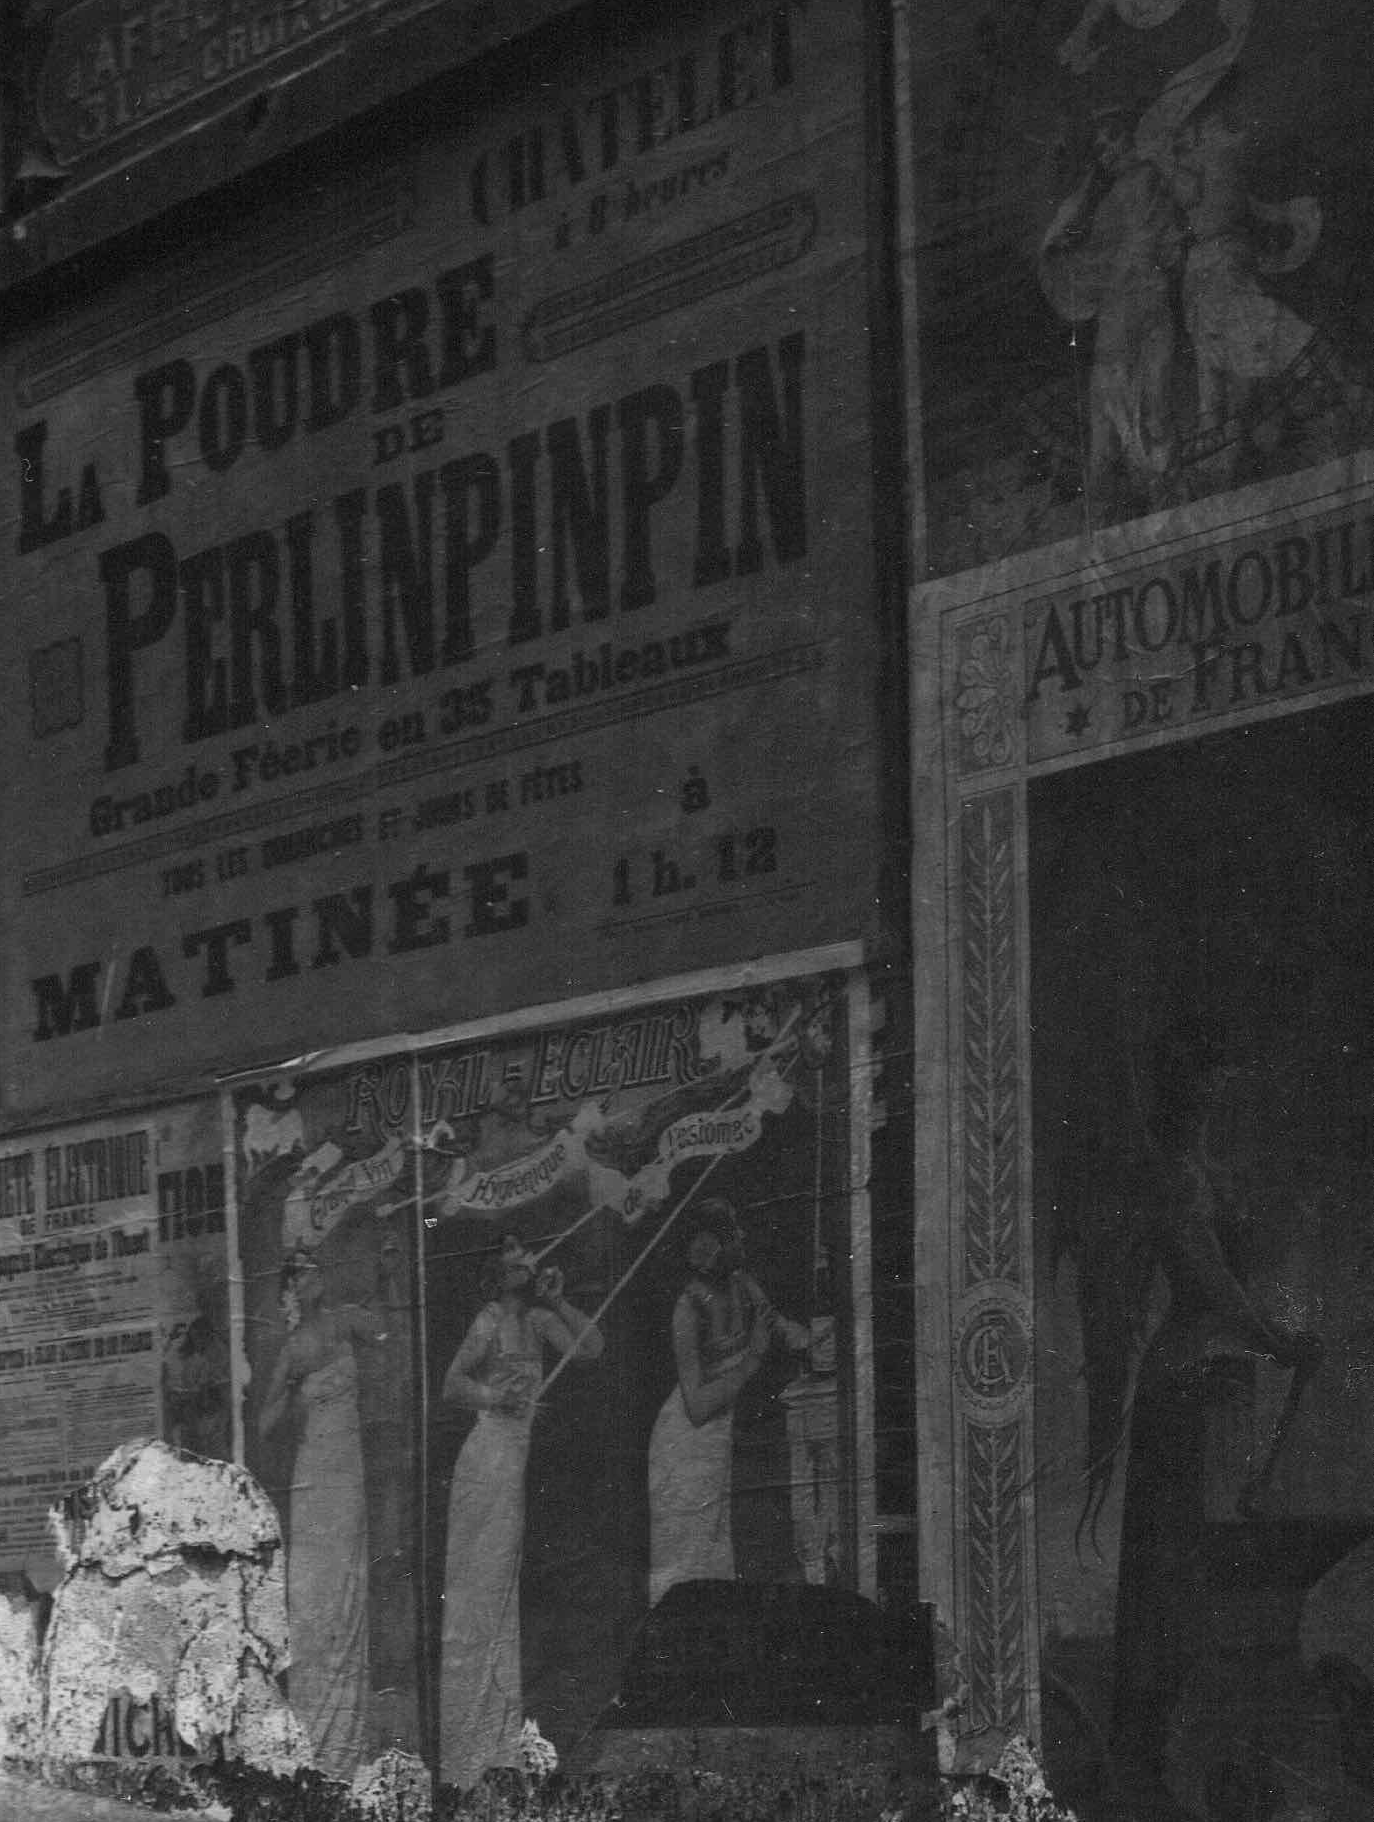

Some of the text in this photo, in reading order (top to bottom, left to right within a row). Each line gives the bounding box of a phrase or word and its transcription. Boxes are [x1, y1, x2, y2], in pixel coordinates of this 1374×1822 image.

[133, 255, 499, 508] POUDRE
[370, 404, 445, 467] DE
[97, 328, 811, 775] PERLINPINPIN
[1024, 518, 1374, 705] AUTOMOBIL
[88, 763, 222, 839] Grande
[230, 718, 364, 794] Féerie
[377, 710, 427, 754] en
[508, 618, 734, 714] Tableaux
[1120, 616, 1374, 729] DE FRAN
[159, 858, 207, 899] TOUS
[215, 847, 250, 883] LES
[485, 779, 512, 815] DE
[29, 850, 531, 1044] MATINÉE
